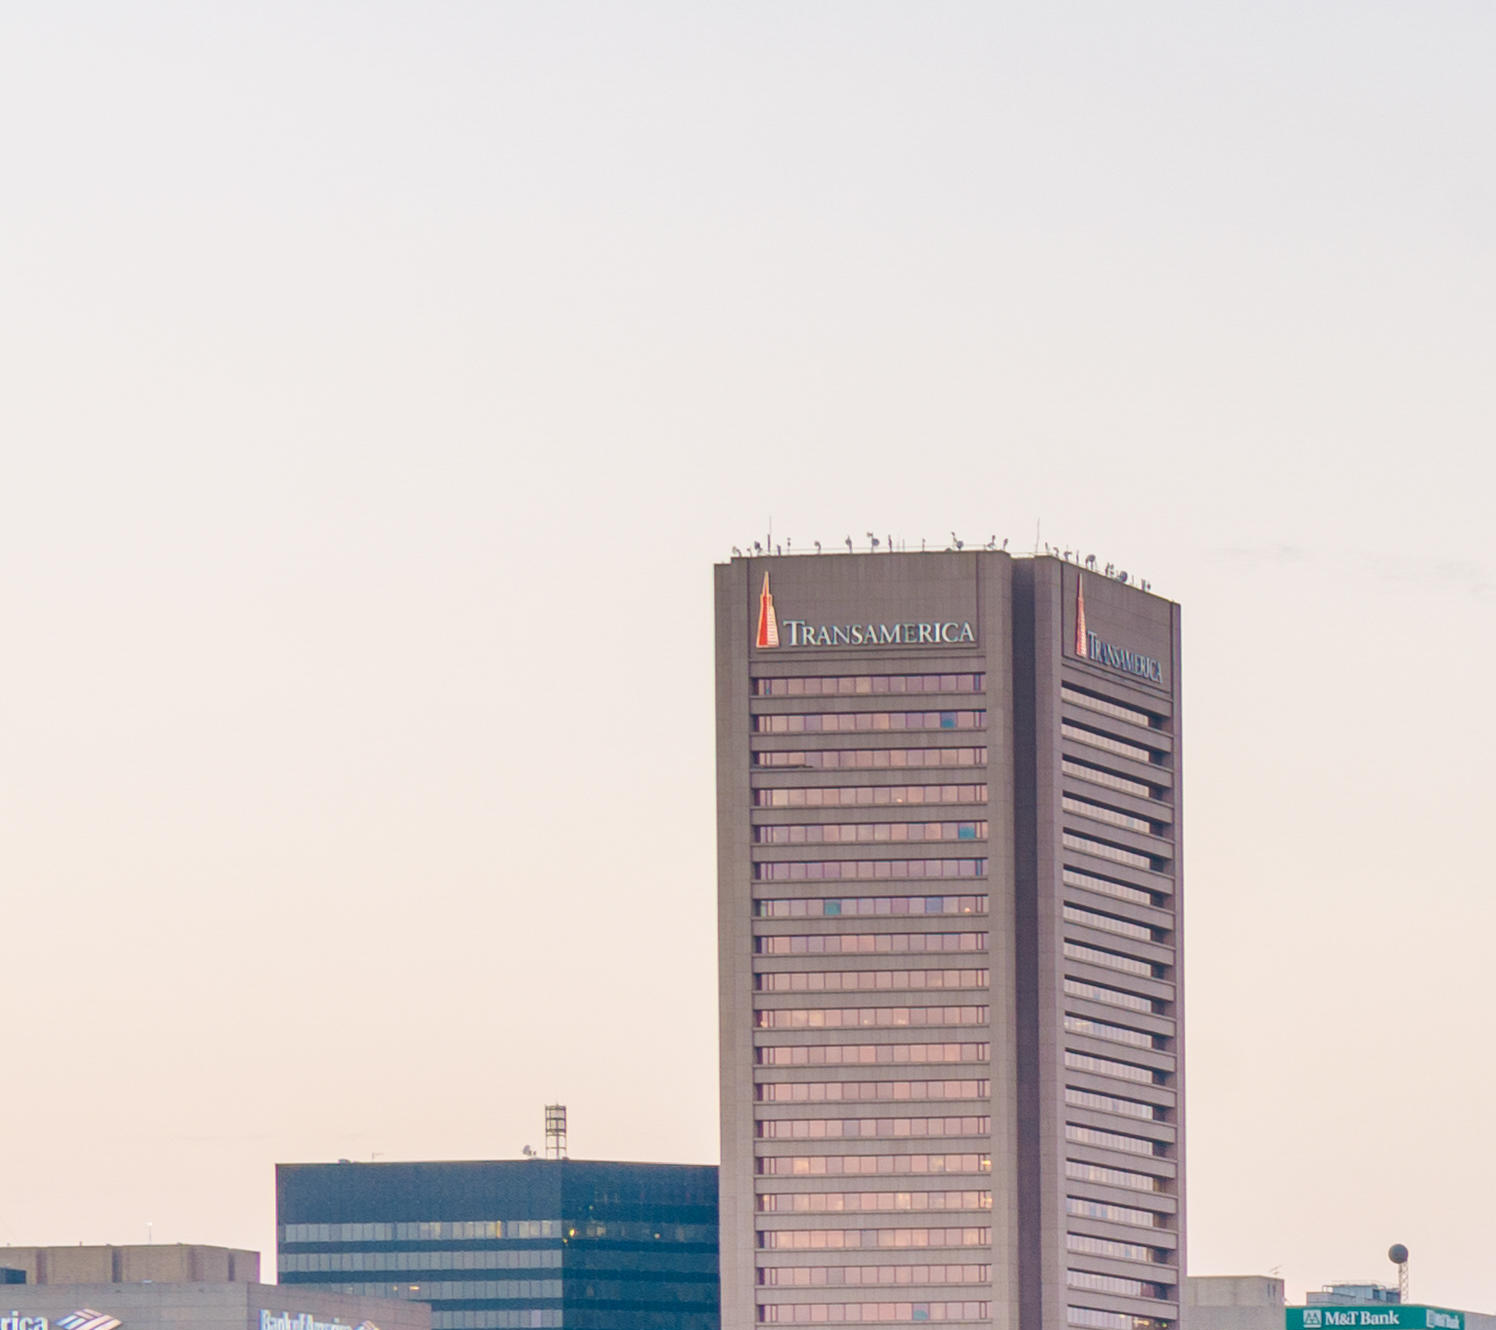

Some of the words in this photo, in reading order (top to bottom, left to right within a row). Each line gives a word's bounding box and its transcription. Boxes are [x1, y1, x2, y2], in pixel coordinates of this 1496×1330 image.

[783, 620, 975, 646] TRANSAMERICA
[1325, 1311, 1359, 1325] M&T
[1360, 1310, 1400, 1325] Bank
